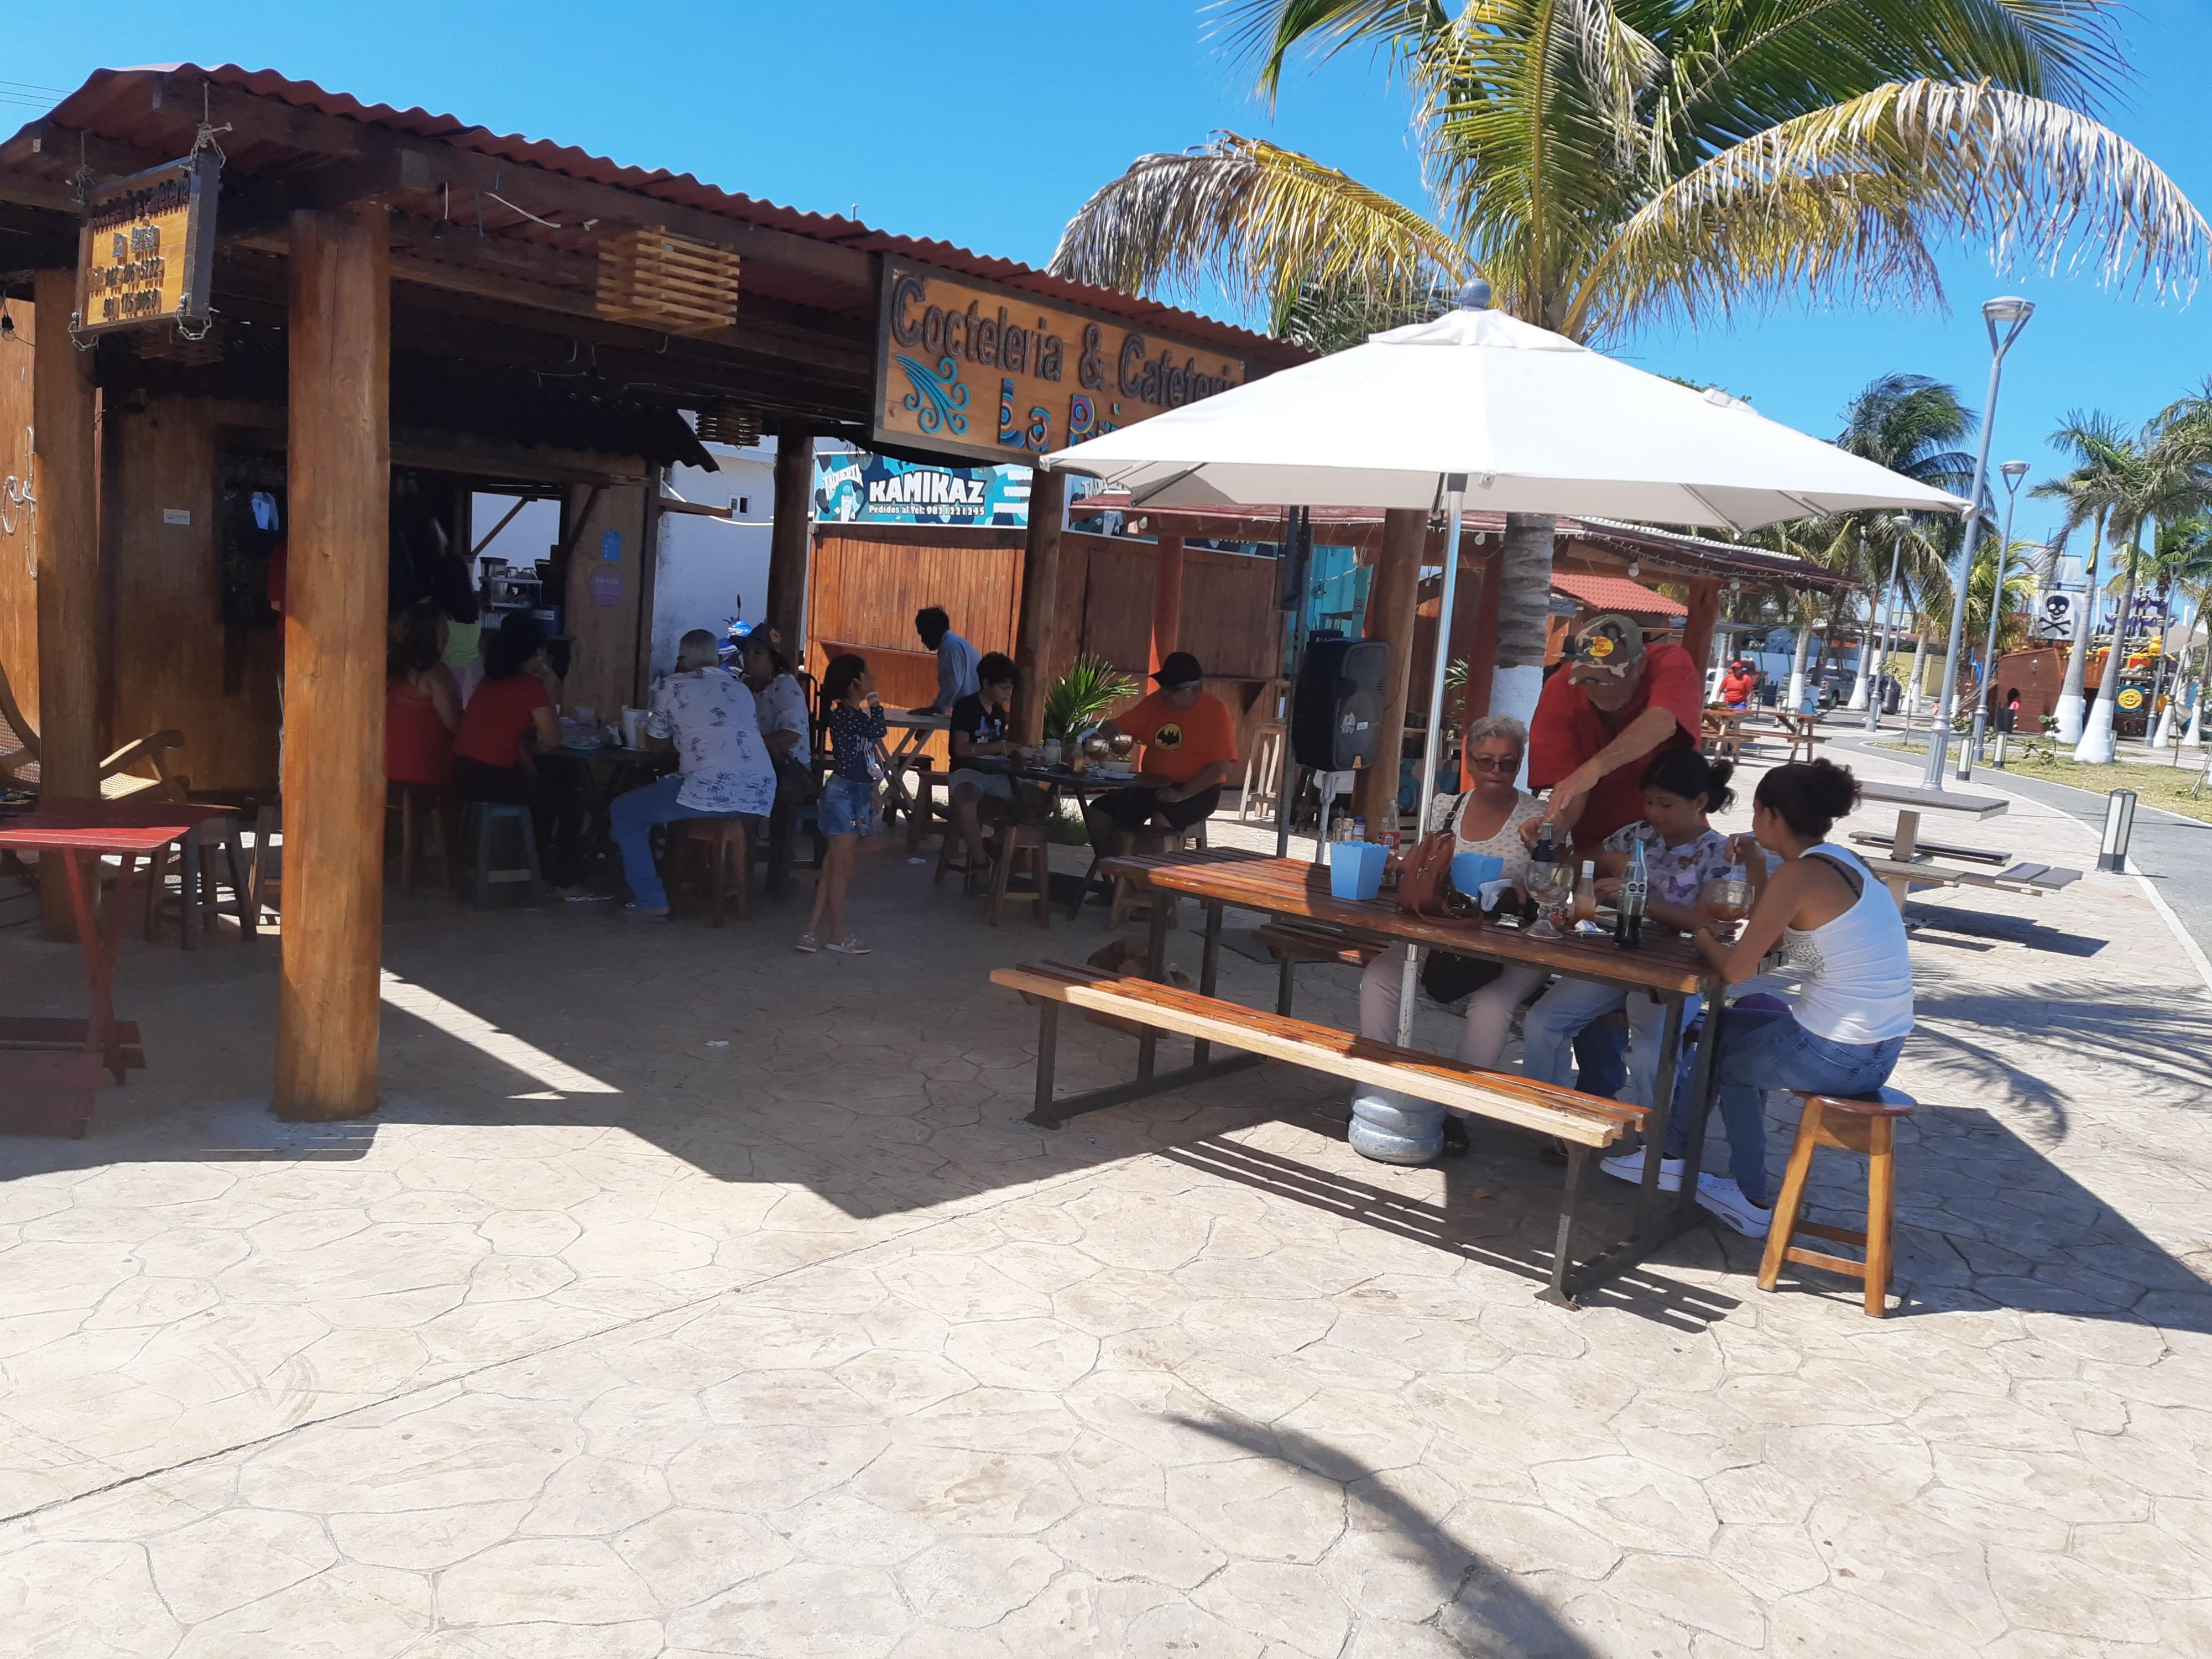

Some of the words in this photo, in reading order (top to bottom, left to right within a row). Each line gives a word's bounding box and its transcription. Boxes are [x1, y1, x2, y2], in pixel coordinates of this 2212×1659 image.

[893, 276, 1063, 382] Cocteleria
[1079, 322, 1105, 390] &
[999, 378, 1051, 452] La
[821, 463, 864, 501] TAQUERIA
[869, 470, 986, 504] KAMIKAZ
[869, 505, 900, 514] Pedidos
[902, 505, 909, 514] al
[911, 506, 925, 514] Tel:
[926, 505, 985, 515] 9821221245
